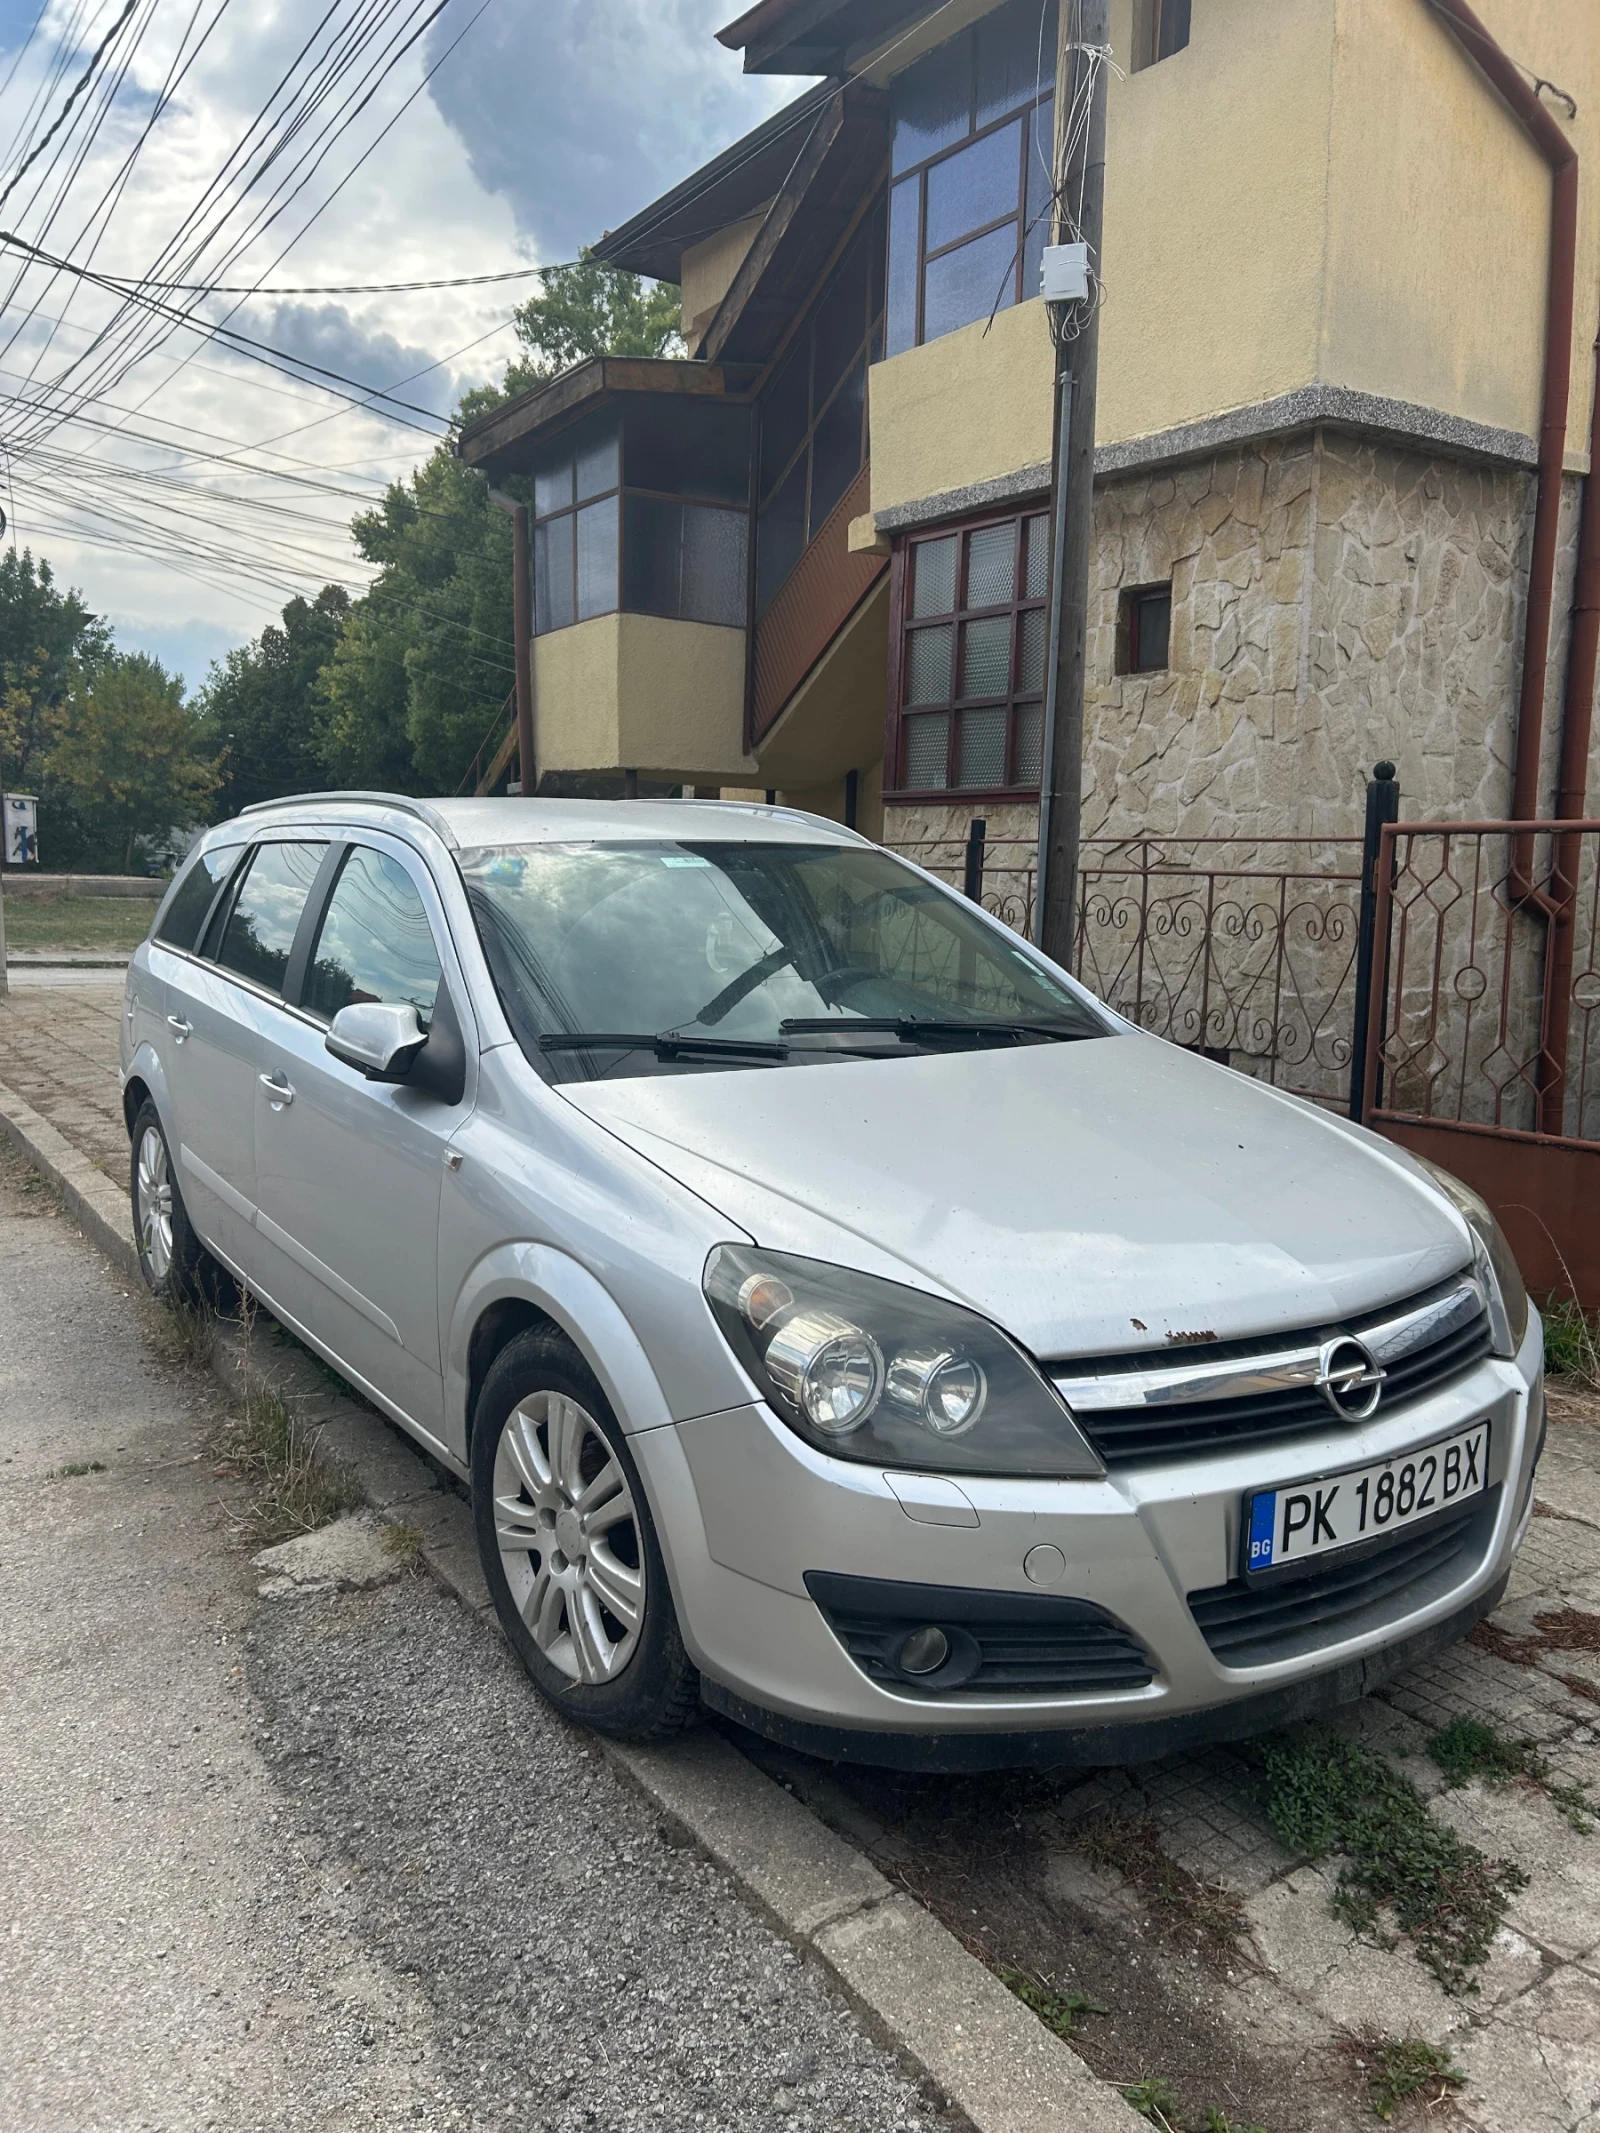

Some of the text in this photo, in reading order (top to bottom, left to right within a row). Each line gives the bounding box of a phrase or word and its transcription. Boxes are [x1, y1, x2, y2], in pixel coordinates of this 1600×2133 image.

[1282, 1434, 1481, 1552] PK 1882 BX
[1251, 1538, 1271, 1558] BG
